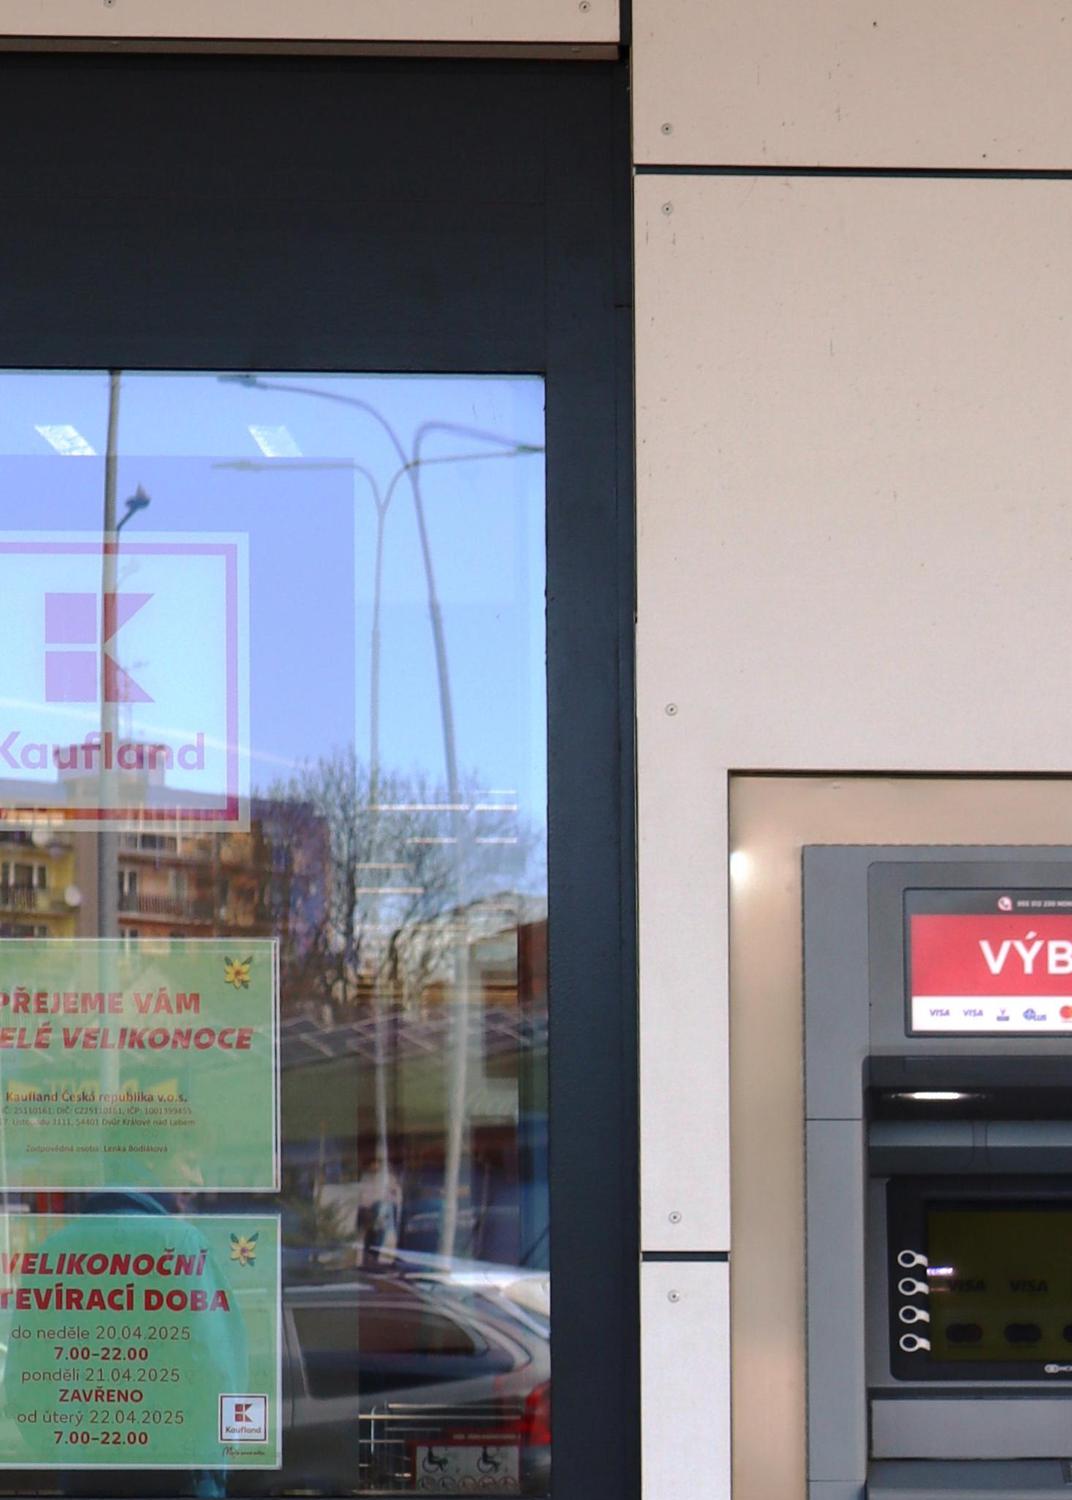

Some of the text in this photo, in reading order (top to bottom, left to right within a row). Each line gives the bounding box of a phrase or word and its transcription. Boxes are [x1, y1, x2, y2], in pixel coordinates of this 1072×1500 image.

[133, 987, 200, 1014] VÁM
[62, 1027, 254, 1050] VELIKONOCE
[1, 1248, 208, 1276] VELIKONOČNÍ
[144, 1289, 230, 1311] DOBA
[11, 1326, 191, 1340] do neděle 20.04.2025
[85, 1368, 180, 1382] 21.04.2025
[59, 1386, 143, 1403] ZAVŘENO
[17, 1410, 184, 1427] od úterý 22.04.2025
[225, 1426, 262, 1434] Kaufland
